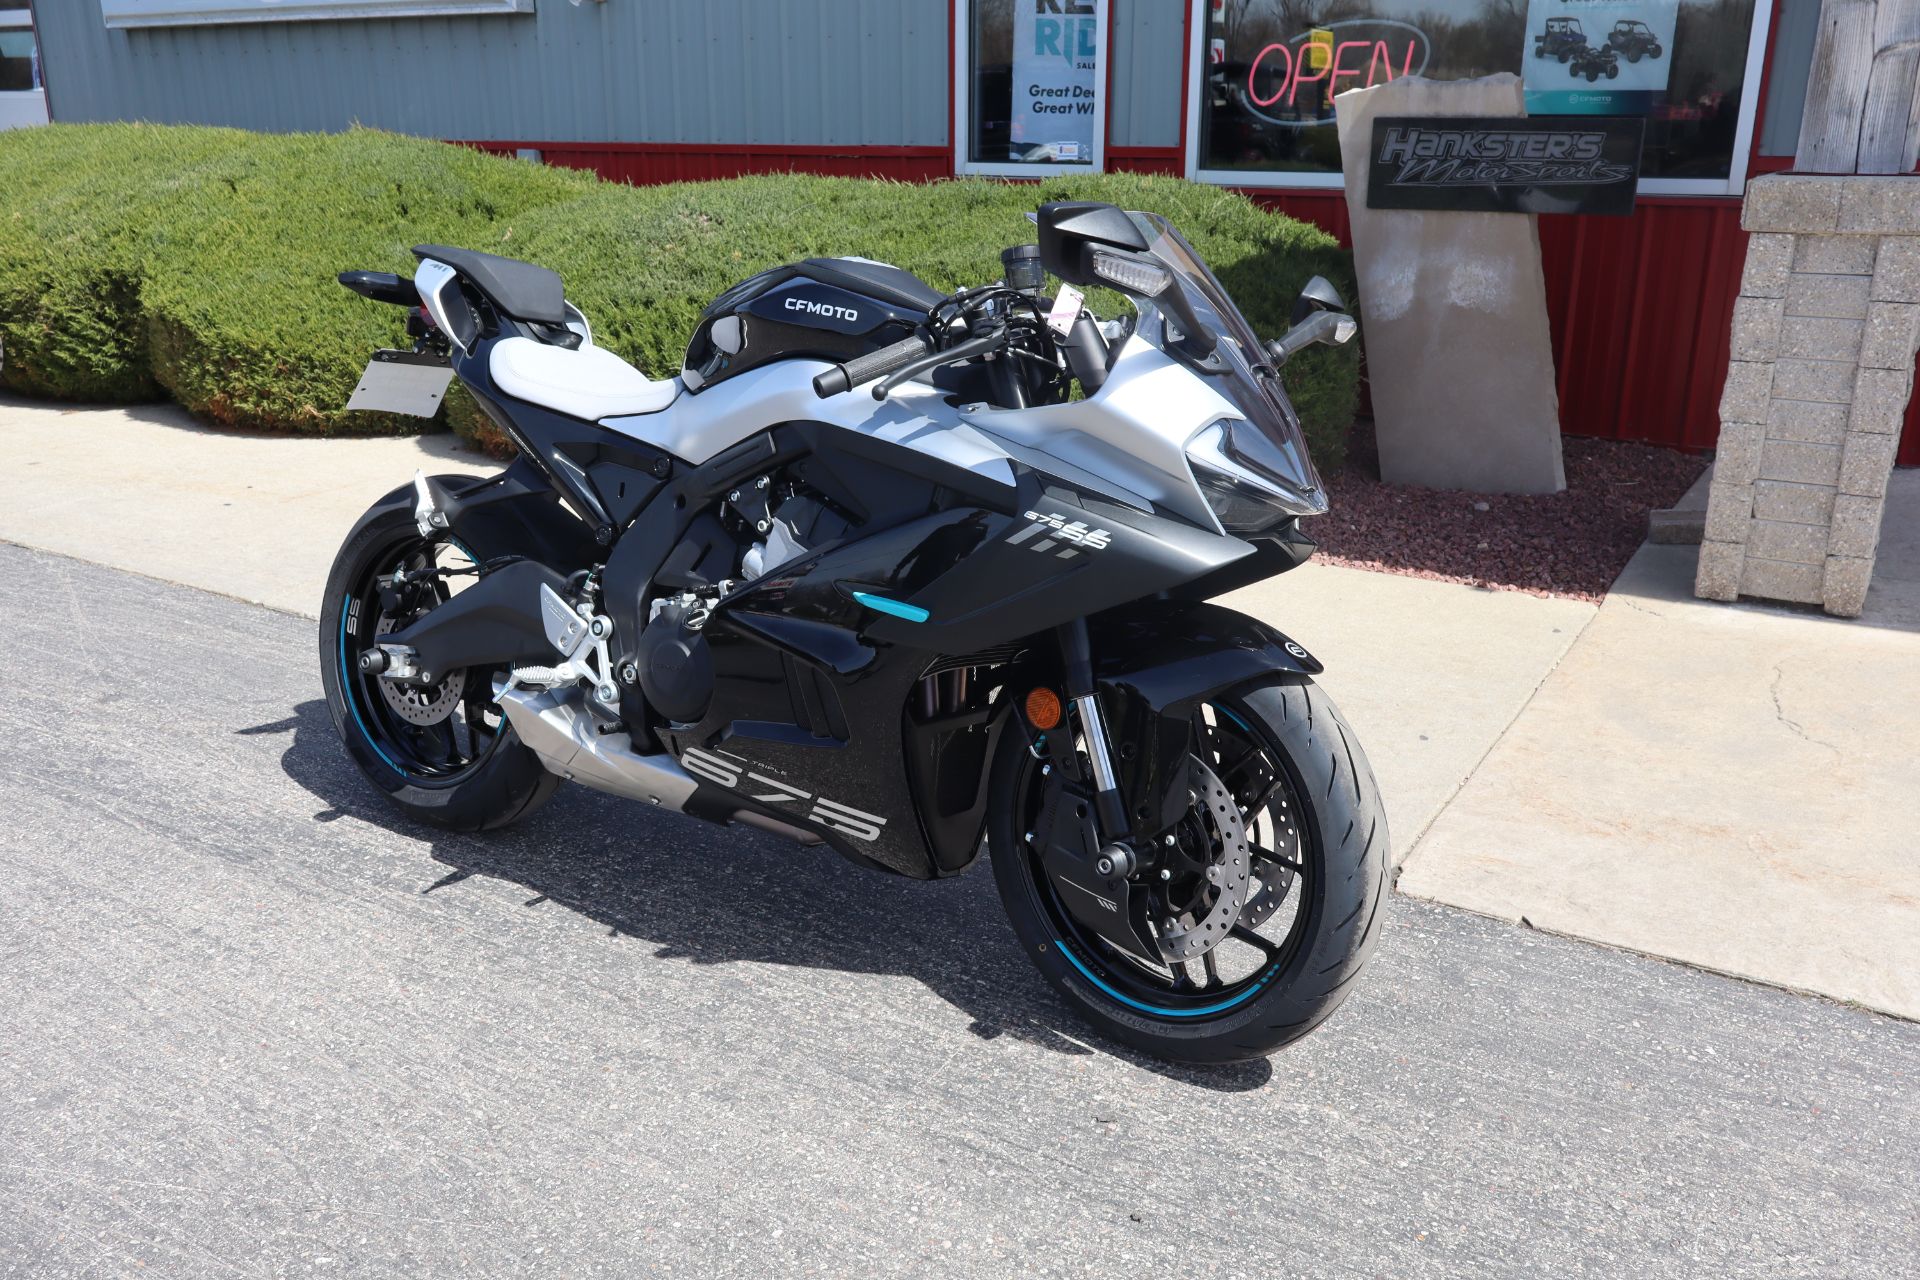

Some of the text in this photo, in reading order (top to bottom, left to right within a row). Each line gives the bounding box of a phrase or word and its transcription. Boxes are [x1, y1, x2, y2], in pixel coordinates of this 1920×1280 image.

[1248, 40, 1415, 107] OPEN
[1029, 84, 1070, 98] Great
[1032, 101, 1073, 114] Great
[785, 297, 858, 322] CFMOTO
[1023, 510, 1066, 530] 675
[1058, 523, 1112, 550] SS
[346, 598, 361, 636] SS
[751, 760, 788, 776] TRIPLE
[681, 747, 888, 842] 675
